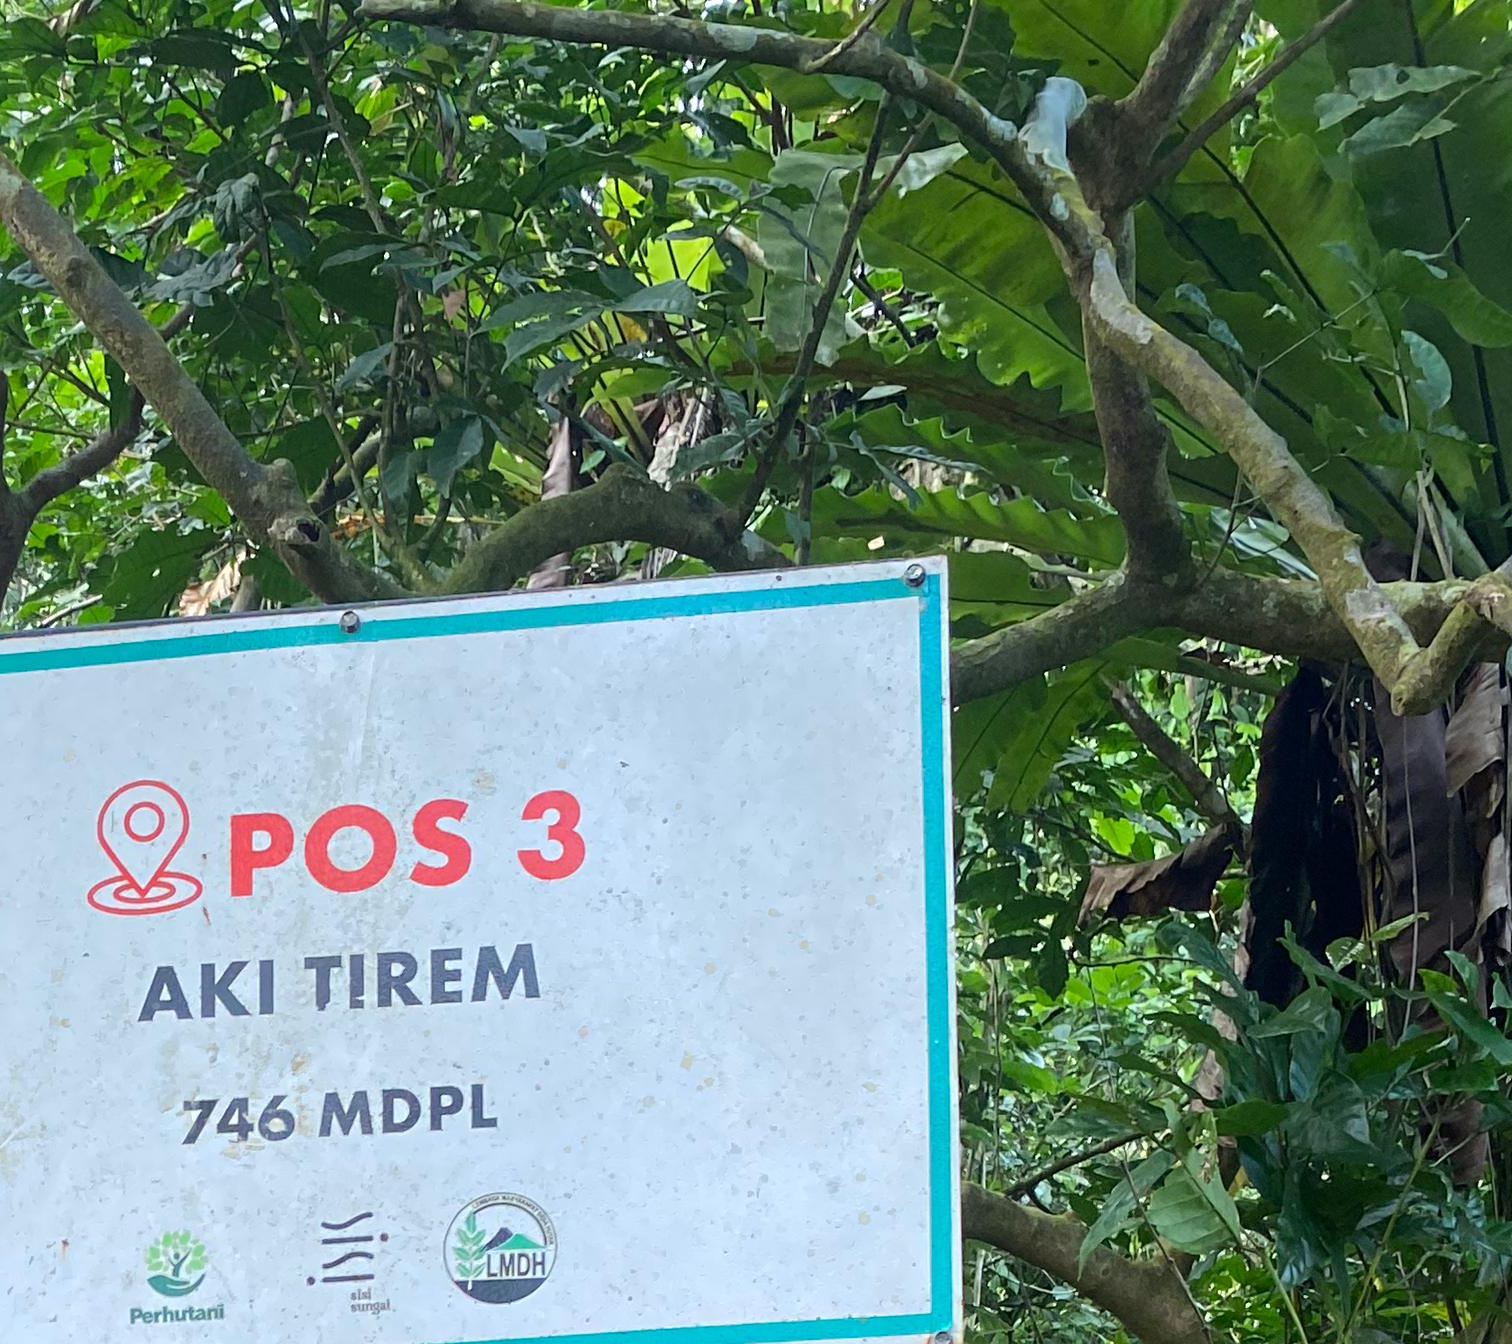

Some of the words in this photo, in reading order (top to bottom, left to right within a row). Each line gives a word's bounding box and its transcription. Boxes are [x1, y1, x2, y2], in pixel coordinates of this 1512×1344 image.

[230, 798, 473, 897] POS
[516, 789, 586, 881] 3
[137, 958, 275, 1022] AKI
[304, 942, 541, 1011] TIREM
[182, 1095, 296, 1145] 746
[318, 1083, 498, 1138] MDPL
[486, 1251, 546, 1278] LMDH
[130, 1303, 225, 1325] Perhutani
